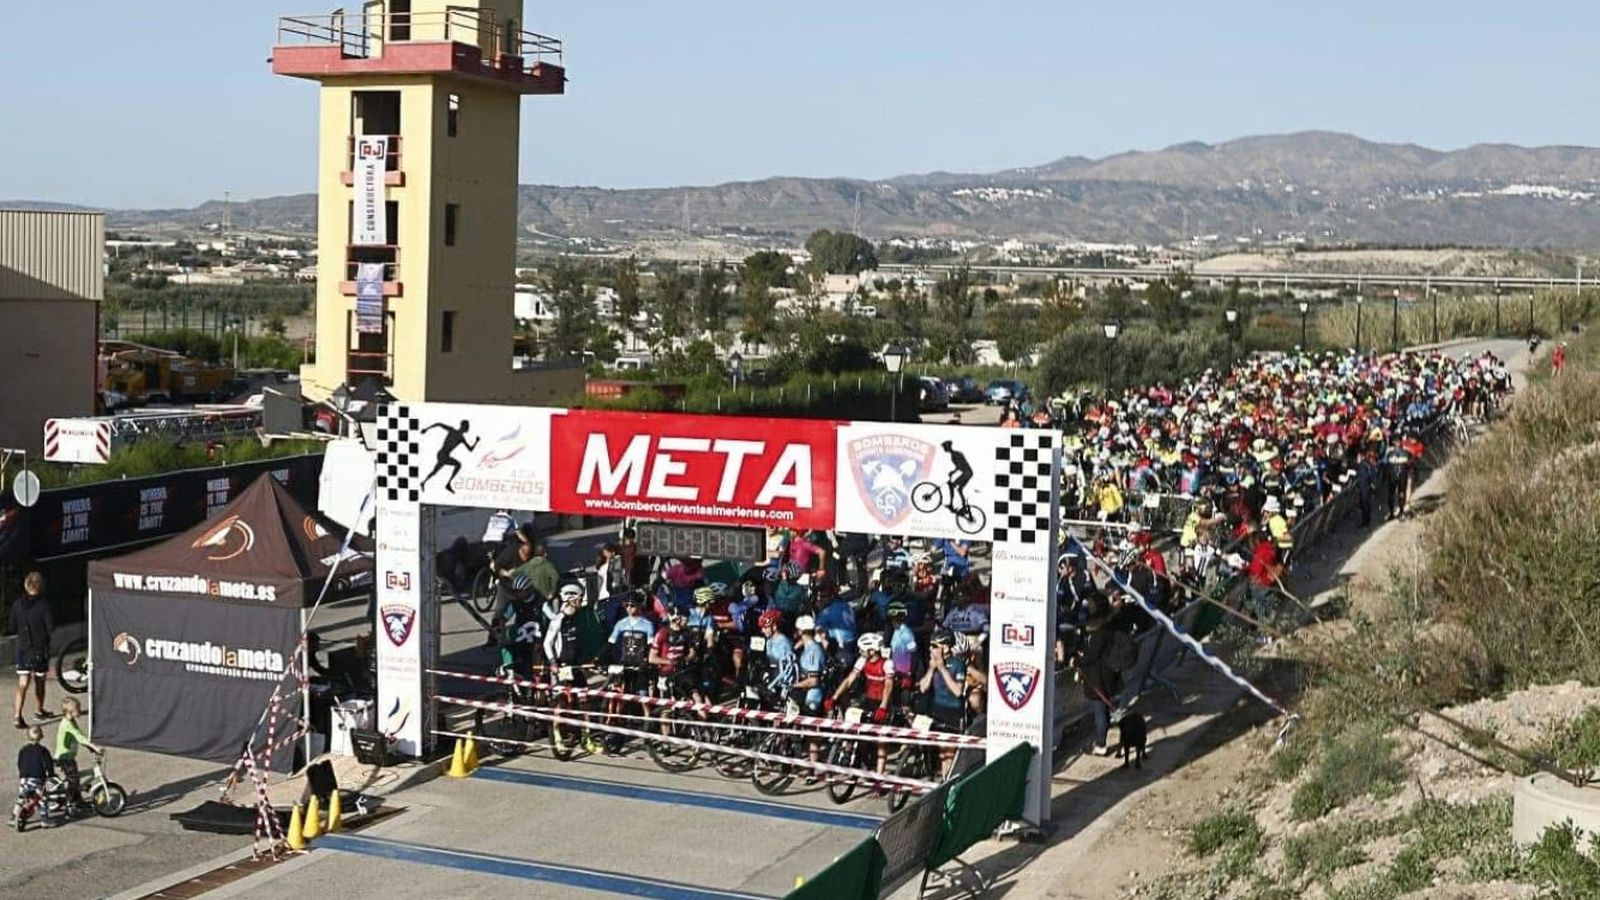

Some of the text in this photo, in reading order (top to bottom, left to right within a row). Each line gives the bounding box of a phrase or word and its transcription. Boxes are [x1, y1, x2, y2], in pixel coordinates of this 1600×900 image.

[366, 163, 376, 232] CONSTRUCTORA
[852, 436, 930, 455] BOMBEROS
[453, 477, 546, 495] BOMBEROS
[576, 433, 813, 508] META
[113, 573, 276, 601] www.cruzandolameta.es
[145, 638, 284, 672] cruzandolameta
